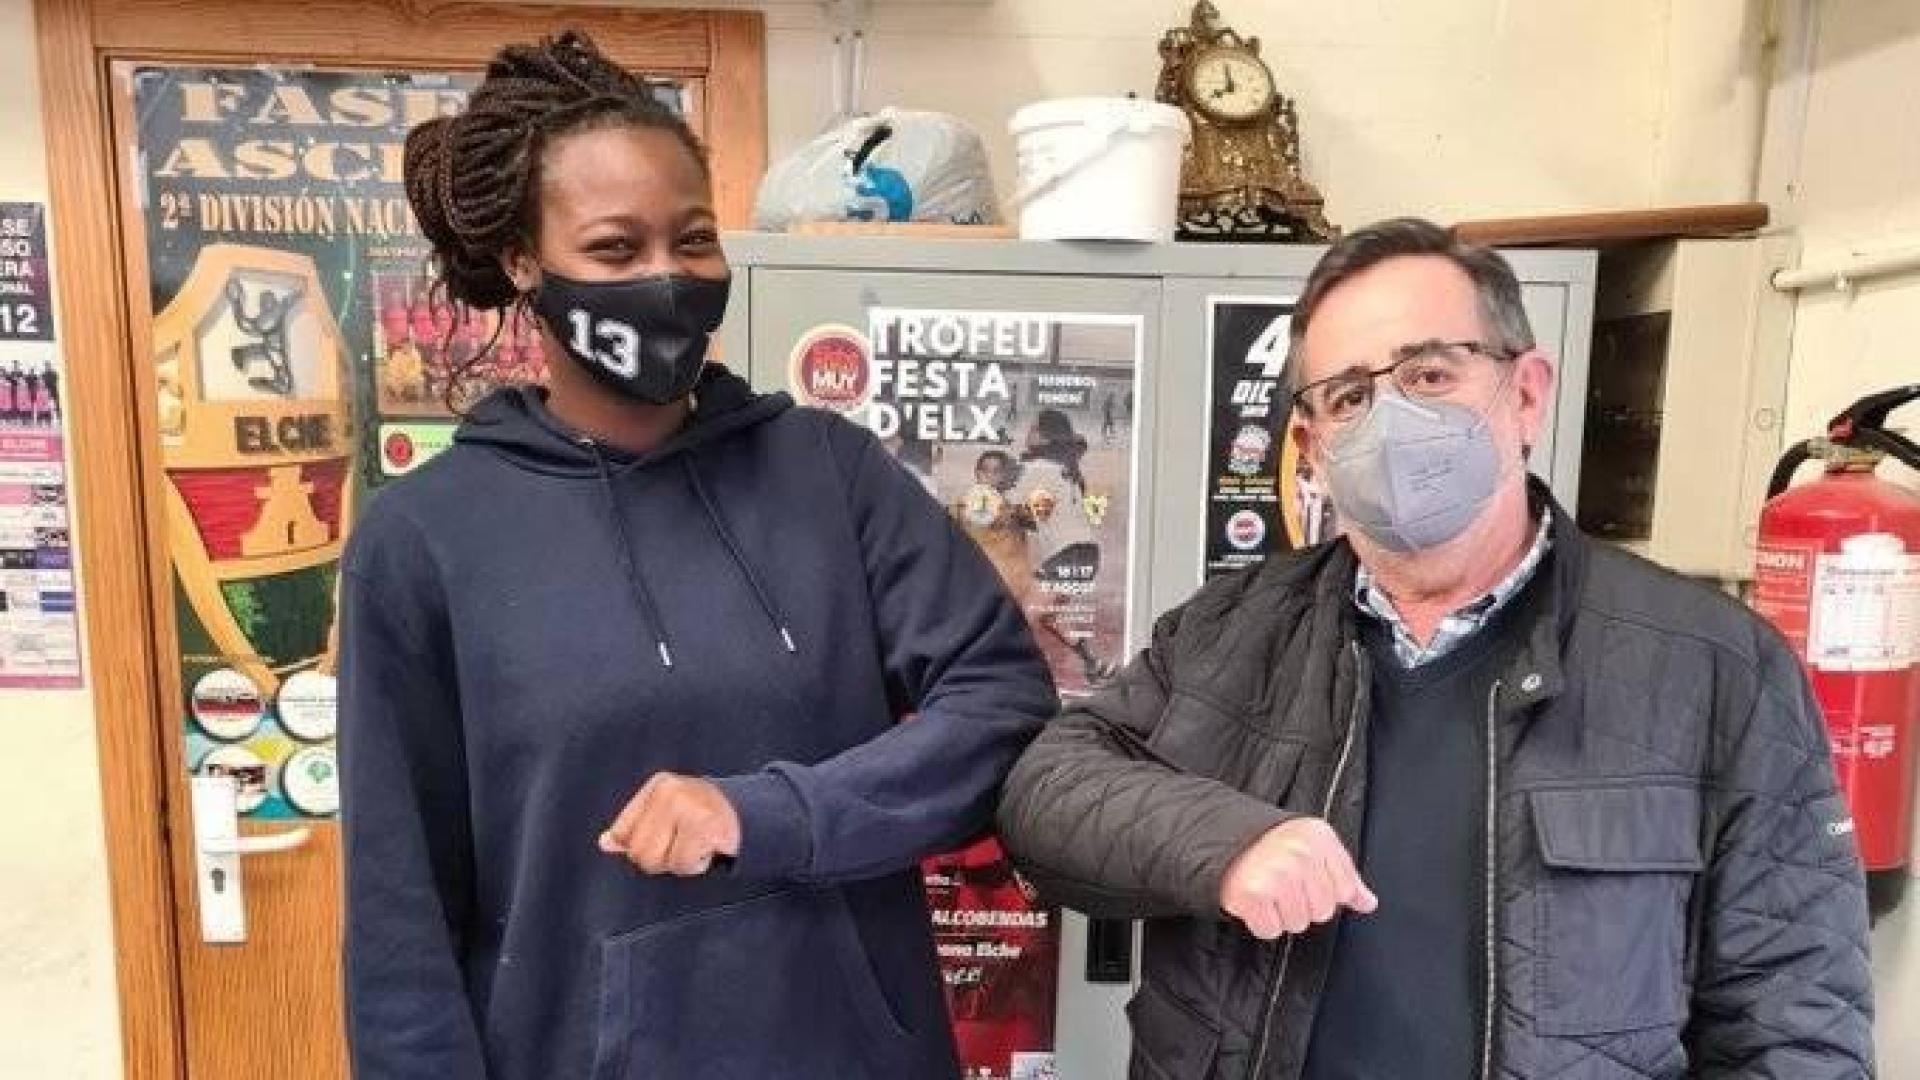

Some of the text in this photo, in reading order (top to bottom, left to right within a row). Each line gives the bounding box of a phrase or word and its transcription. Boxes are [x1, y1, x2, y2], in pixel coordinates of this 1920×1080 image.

[178, 81, 467, 127] FASE
[199, 189, 335, 236] DIVISIÓN
[567, 309, 639, 380] 13
[872, 315, 1049, 356] TROFEU
[1245, 314, 1293, 378] 4
[872, 359, 1009, 399] FESTA
[1231, 379, 1277, 404] DIC
